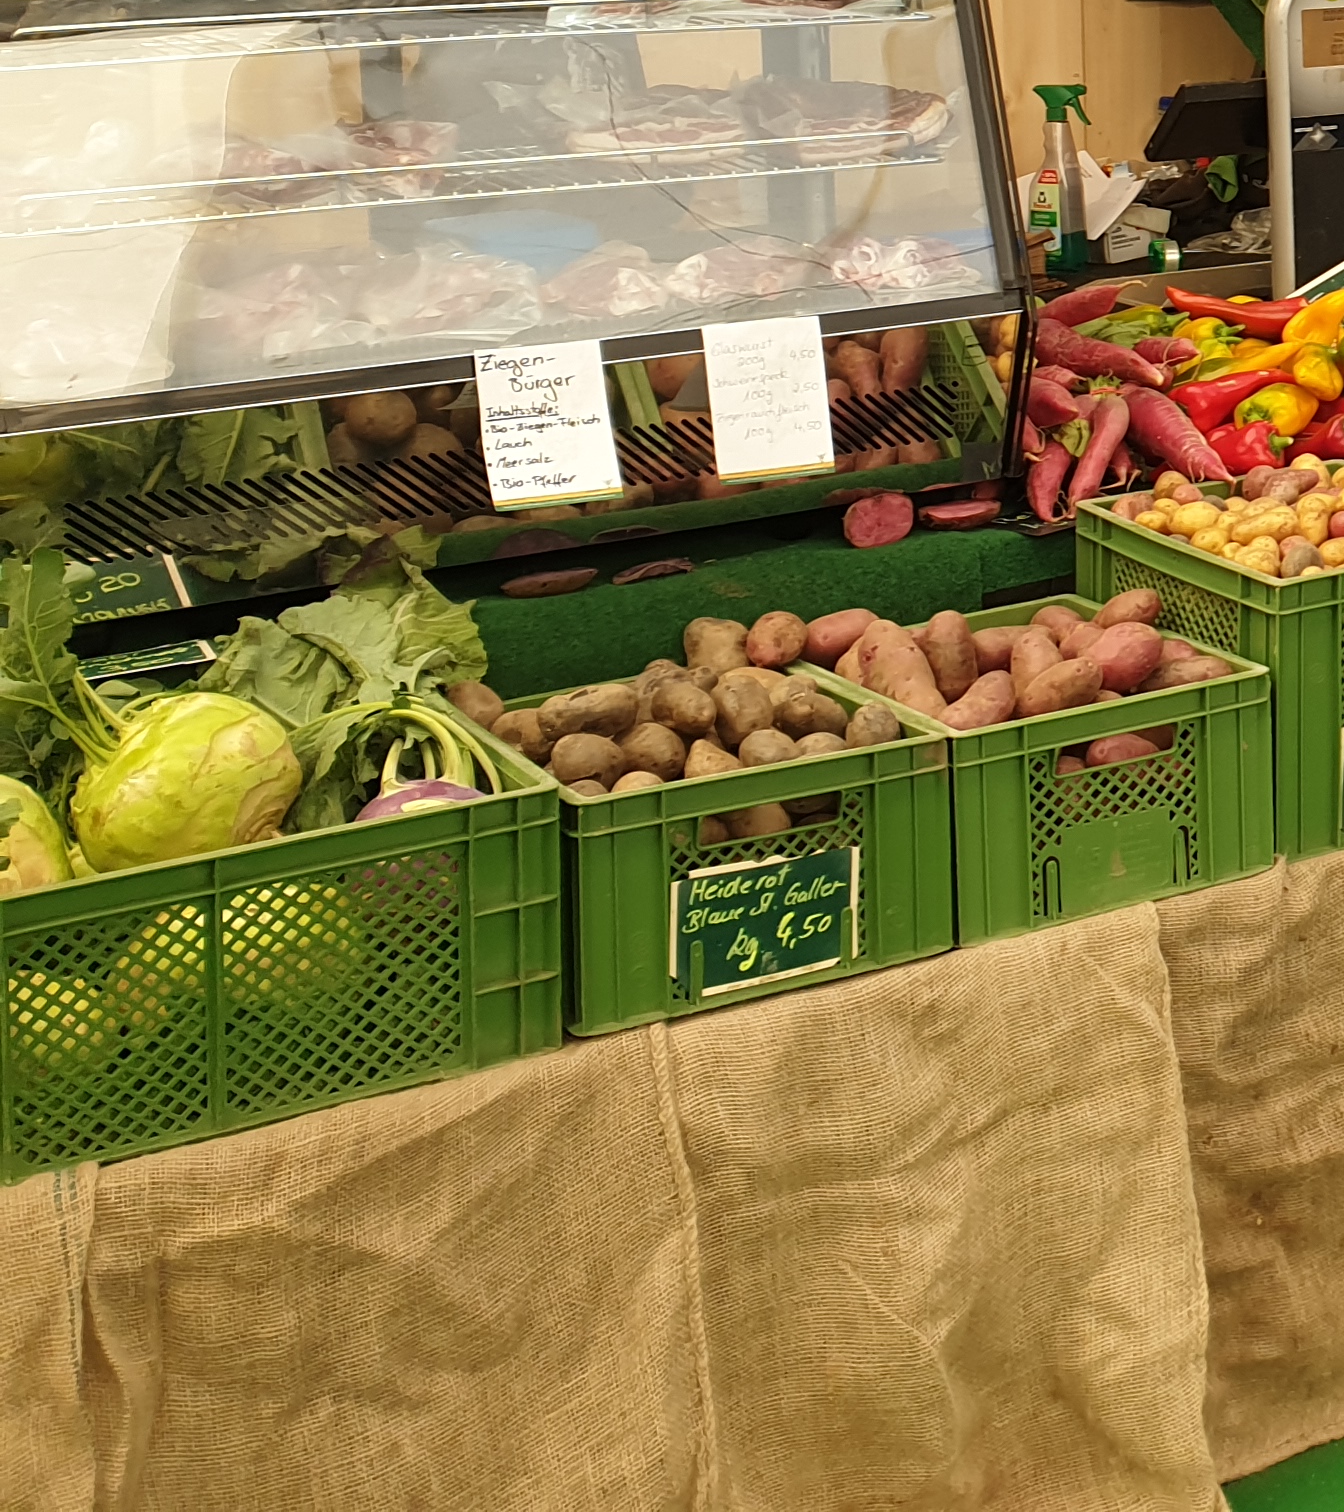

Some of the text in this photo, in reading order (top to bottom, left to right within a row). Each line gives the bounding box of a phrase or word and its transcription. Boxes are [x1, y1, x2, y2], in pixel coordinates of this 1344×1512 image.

[682, 906, 746, 934] Blaue
[784, 875, 847, 906] Galler
[776, 910, 833, 950] 4,50
